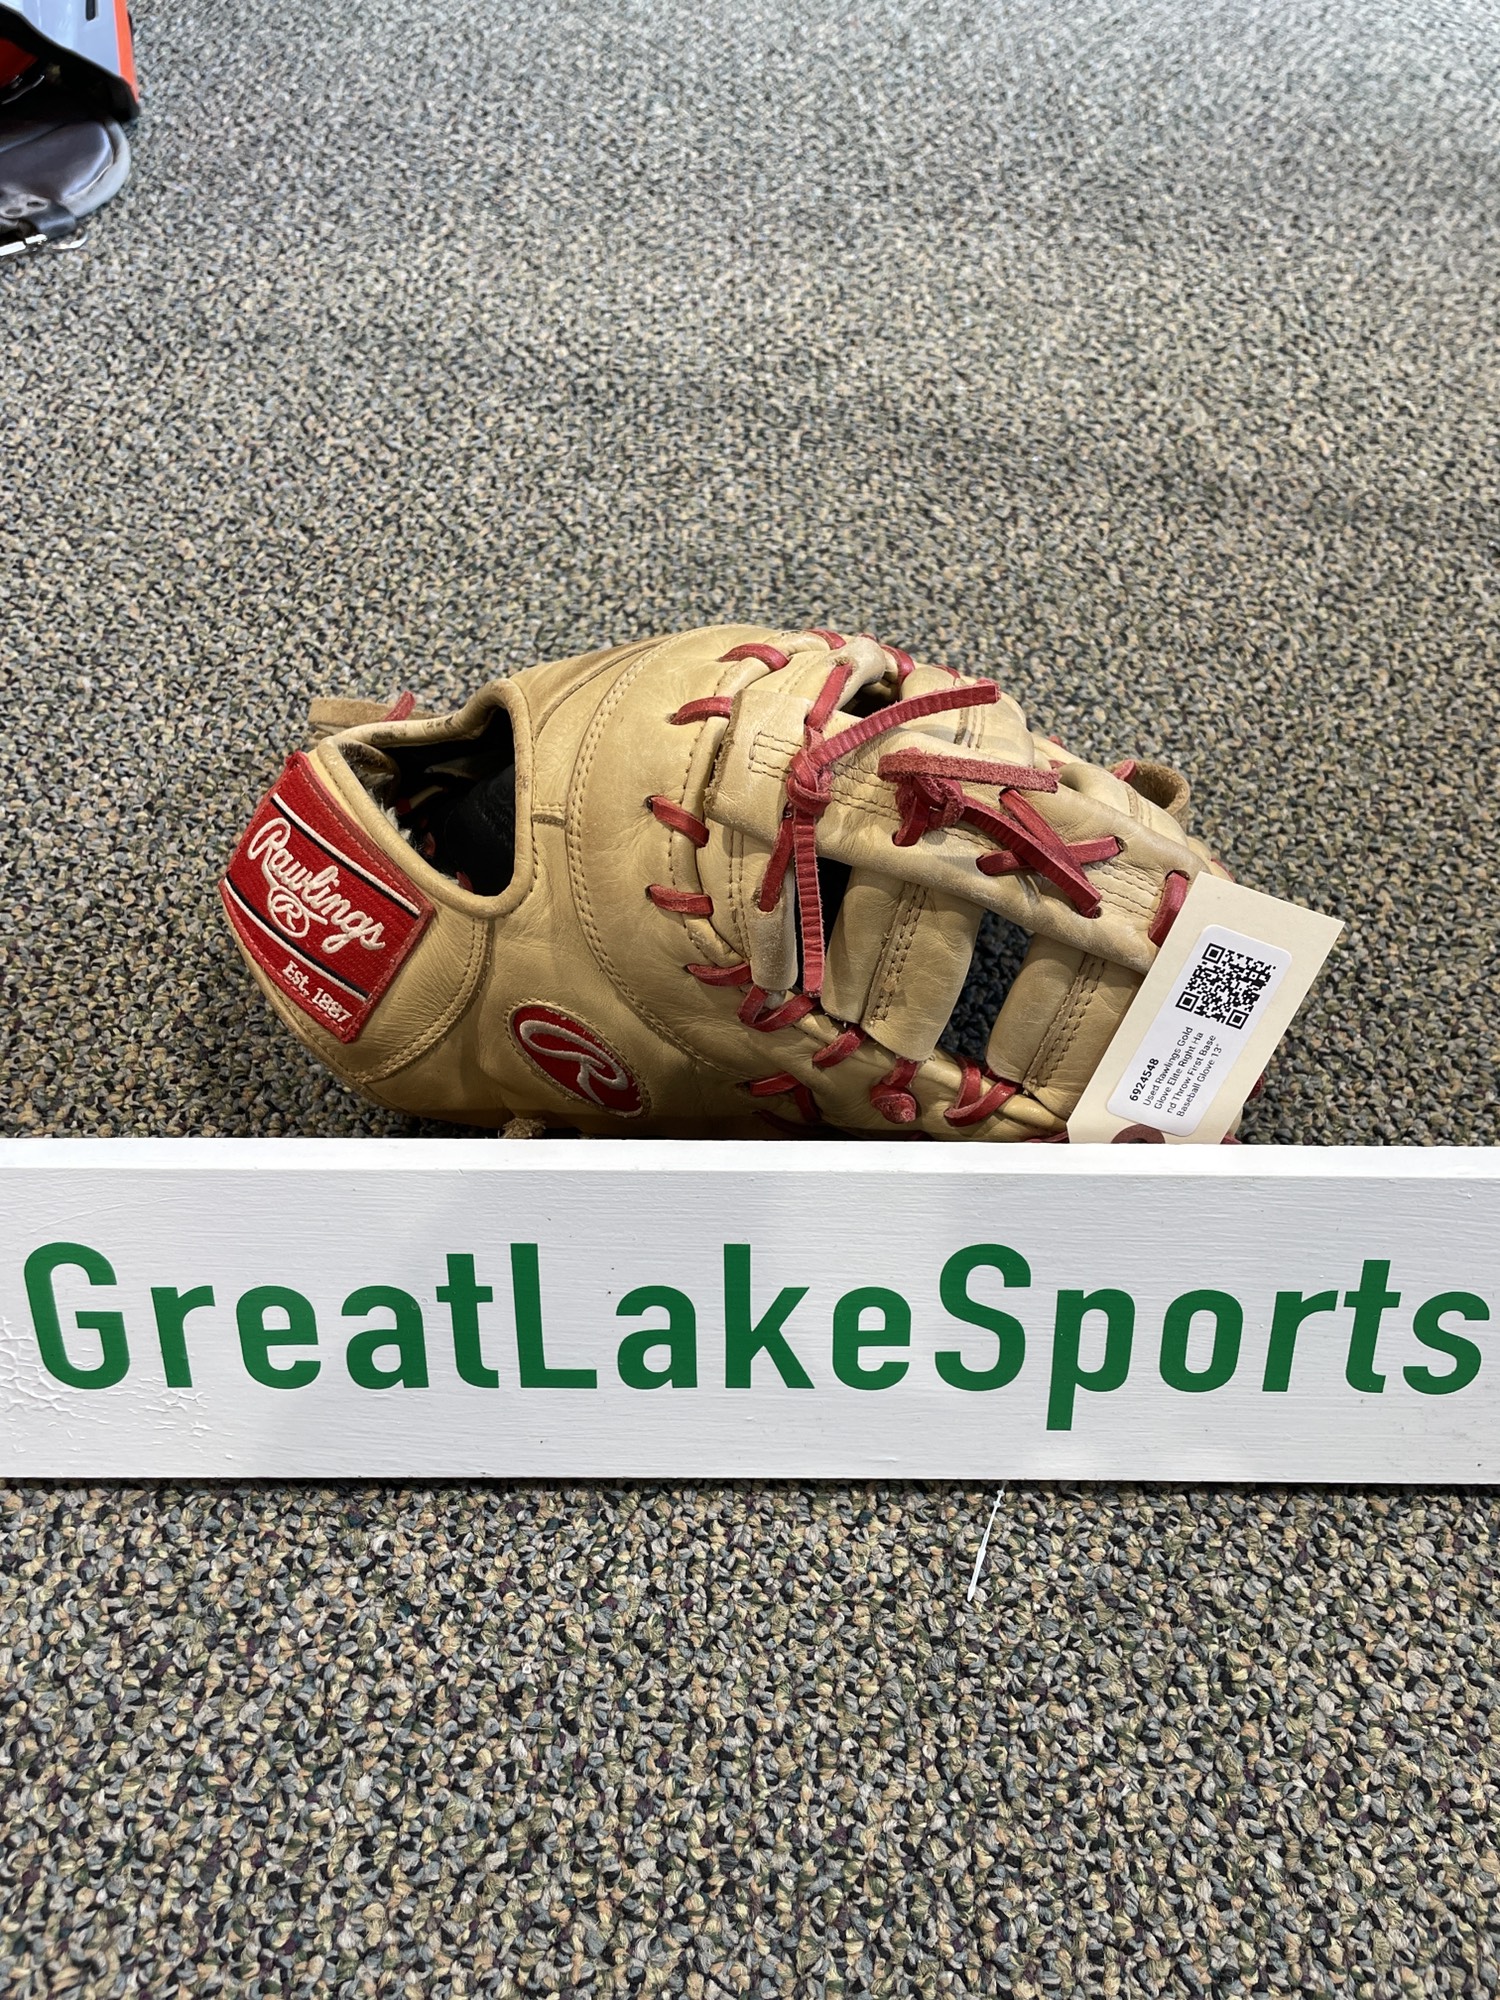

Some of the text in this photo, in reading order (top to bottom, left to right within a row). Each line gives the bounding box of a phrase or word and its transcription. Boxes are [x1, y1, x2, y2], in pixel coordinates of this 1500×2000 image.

[247, 817, 386, 954] Rawlings
[281, 960, 353, 1023] Est. 1887
[1129, 1058, 1160, 1102] 6924548
[1143, 1026, 1193, 1106] Used Rawlings Gold
[1154, 1032, 1204, 1110] Glove Elite Right Ha
[1167, 1035, 1216, 1114] nd Throw First Base
[1176, 1083, 1201, 1117] Baseball
[1197, 1060, 1215, 1082] Glove
[25, 1243, 1490, 1431] GreatLakeSports
